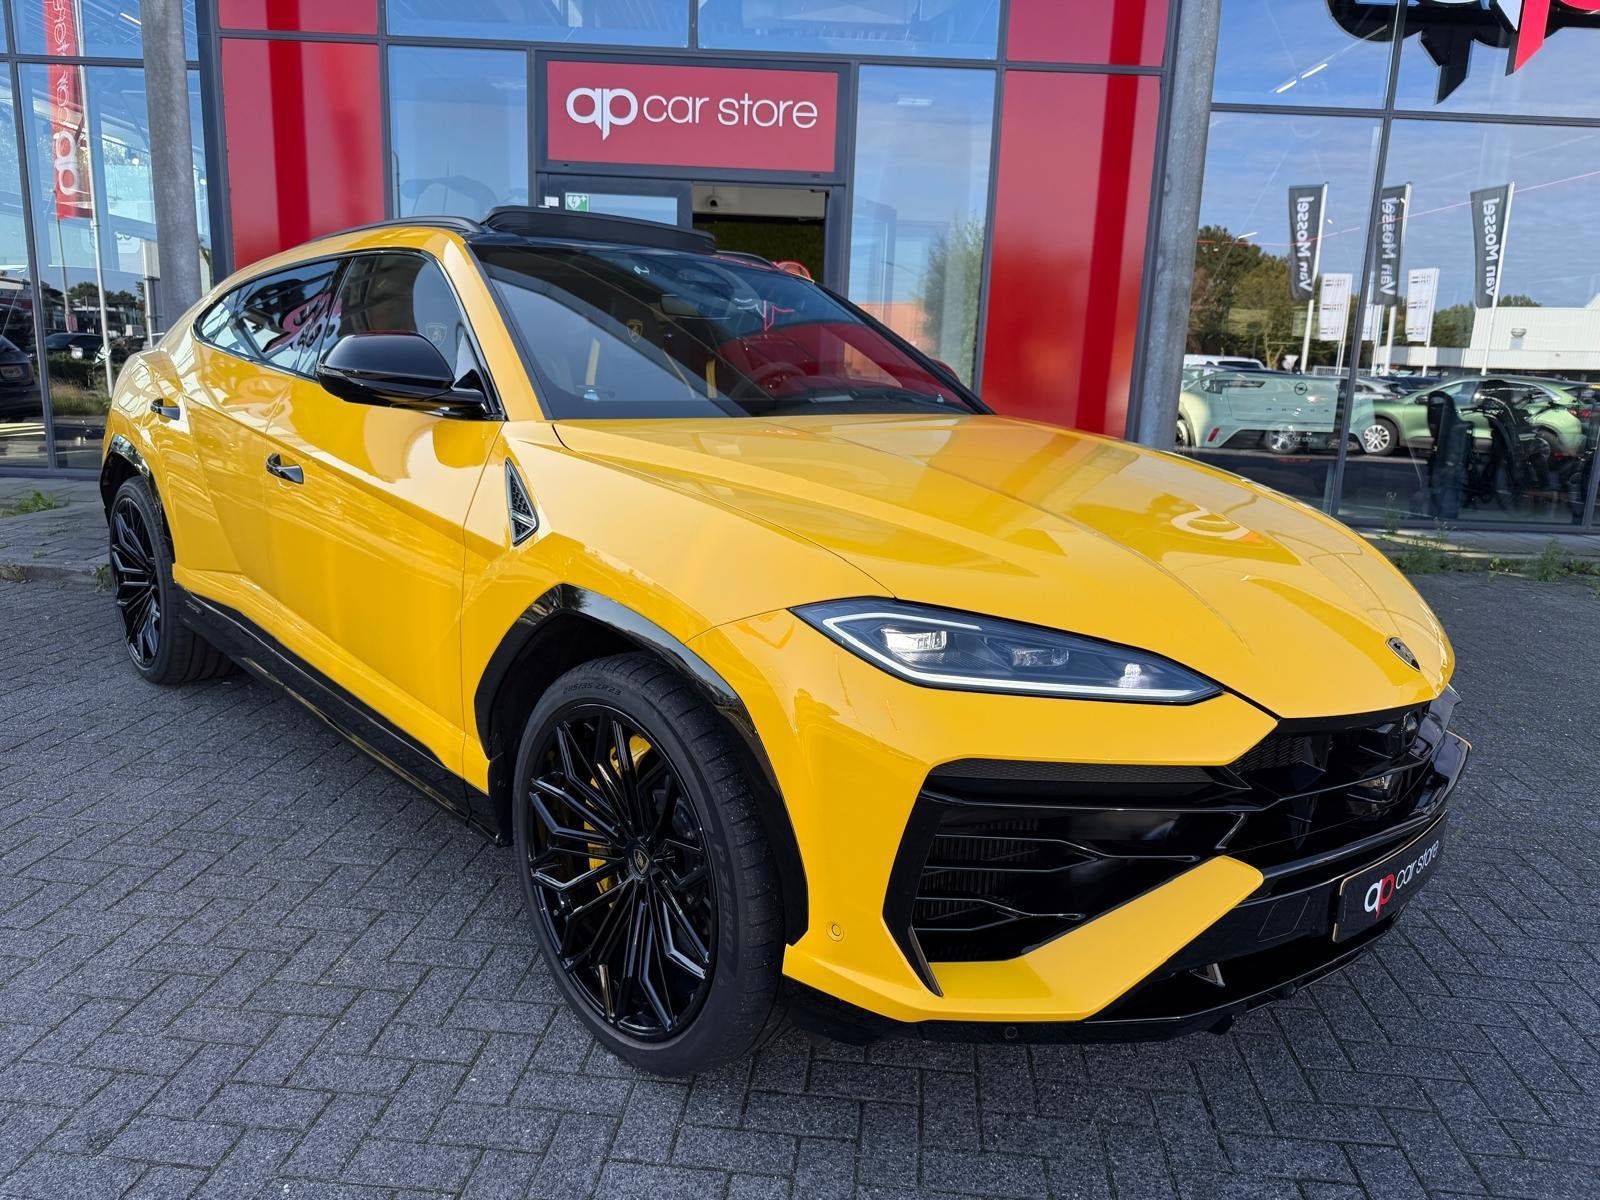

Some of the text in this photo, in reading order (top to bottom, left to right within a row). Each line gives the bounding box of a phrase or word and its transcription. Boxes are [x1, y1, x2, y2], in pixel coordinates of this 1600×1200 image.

[566, 87, 818, 141] ap car store
[1364, 840, 1439, 920] ap car store
